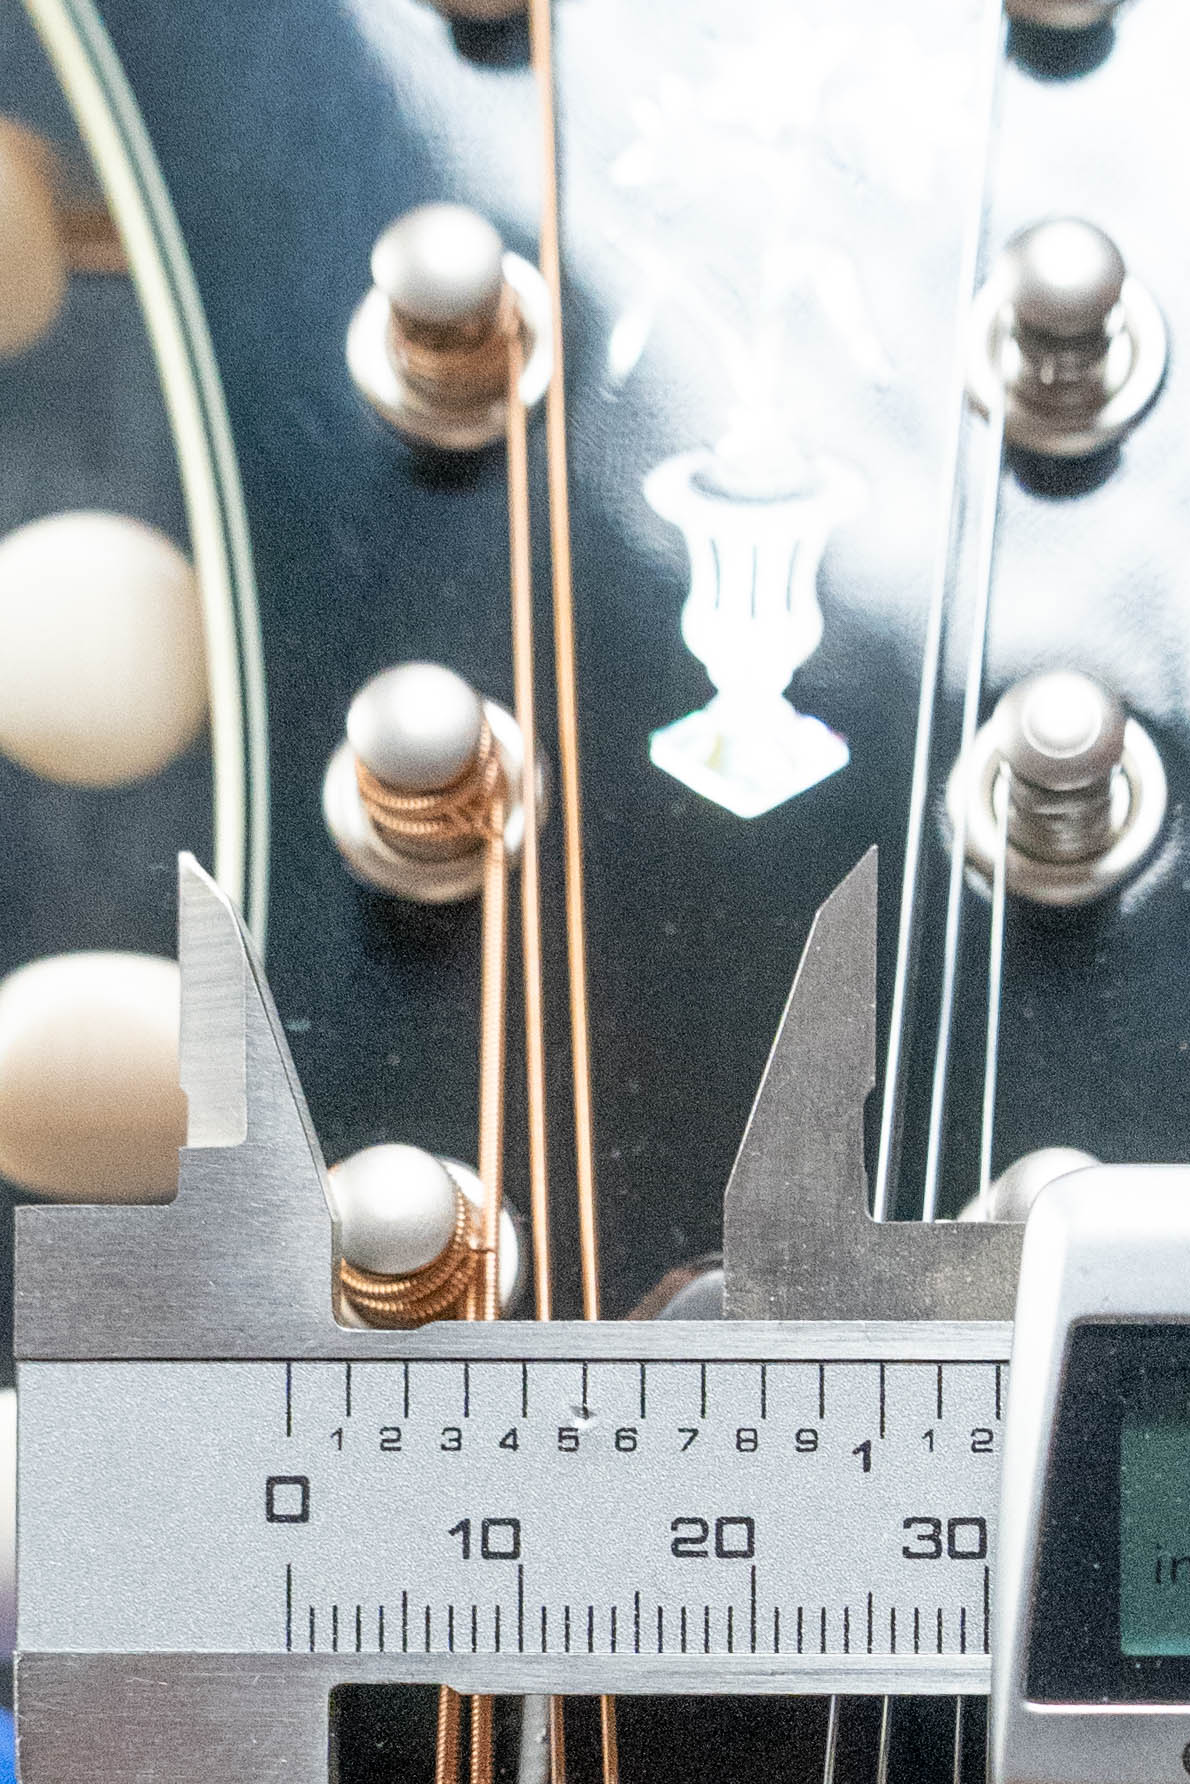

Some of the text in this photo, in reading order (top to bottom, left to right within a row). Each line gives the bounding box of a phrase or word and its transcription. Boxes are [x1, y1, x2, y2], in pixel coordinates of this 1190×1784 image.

[330, 1426, 995, 1473] 1 2 3 4 5 6 7 8 9 1 1 2
[264, 1475, 988, 1561] 0 10 20 30
